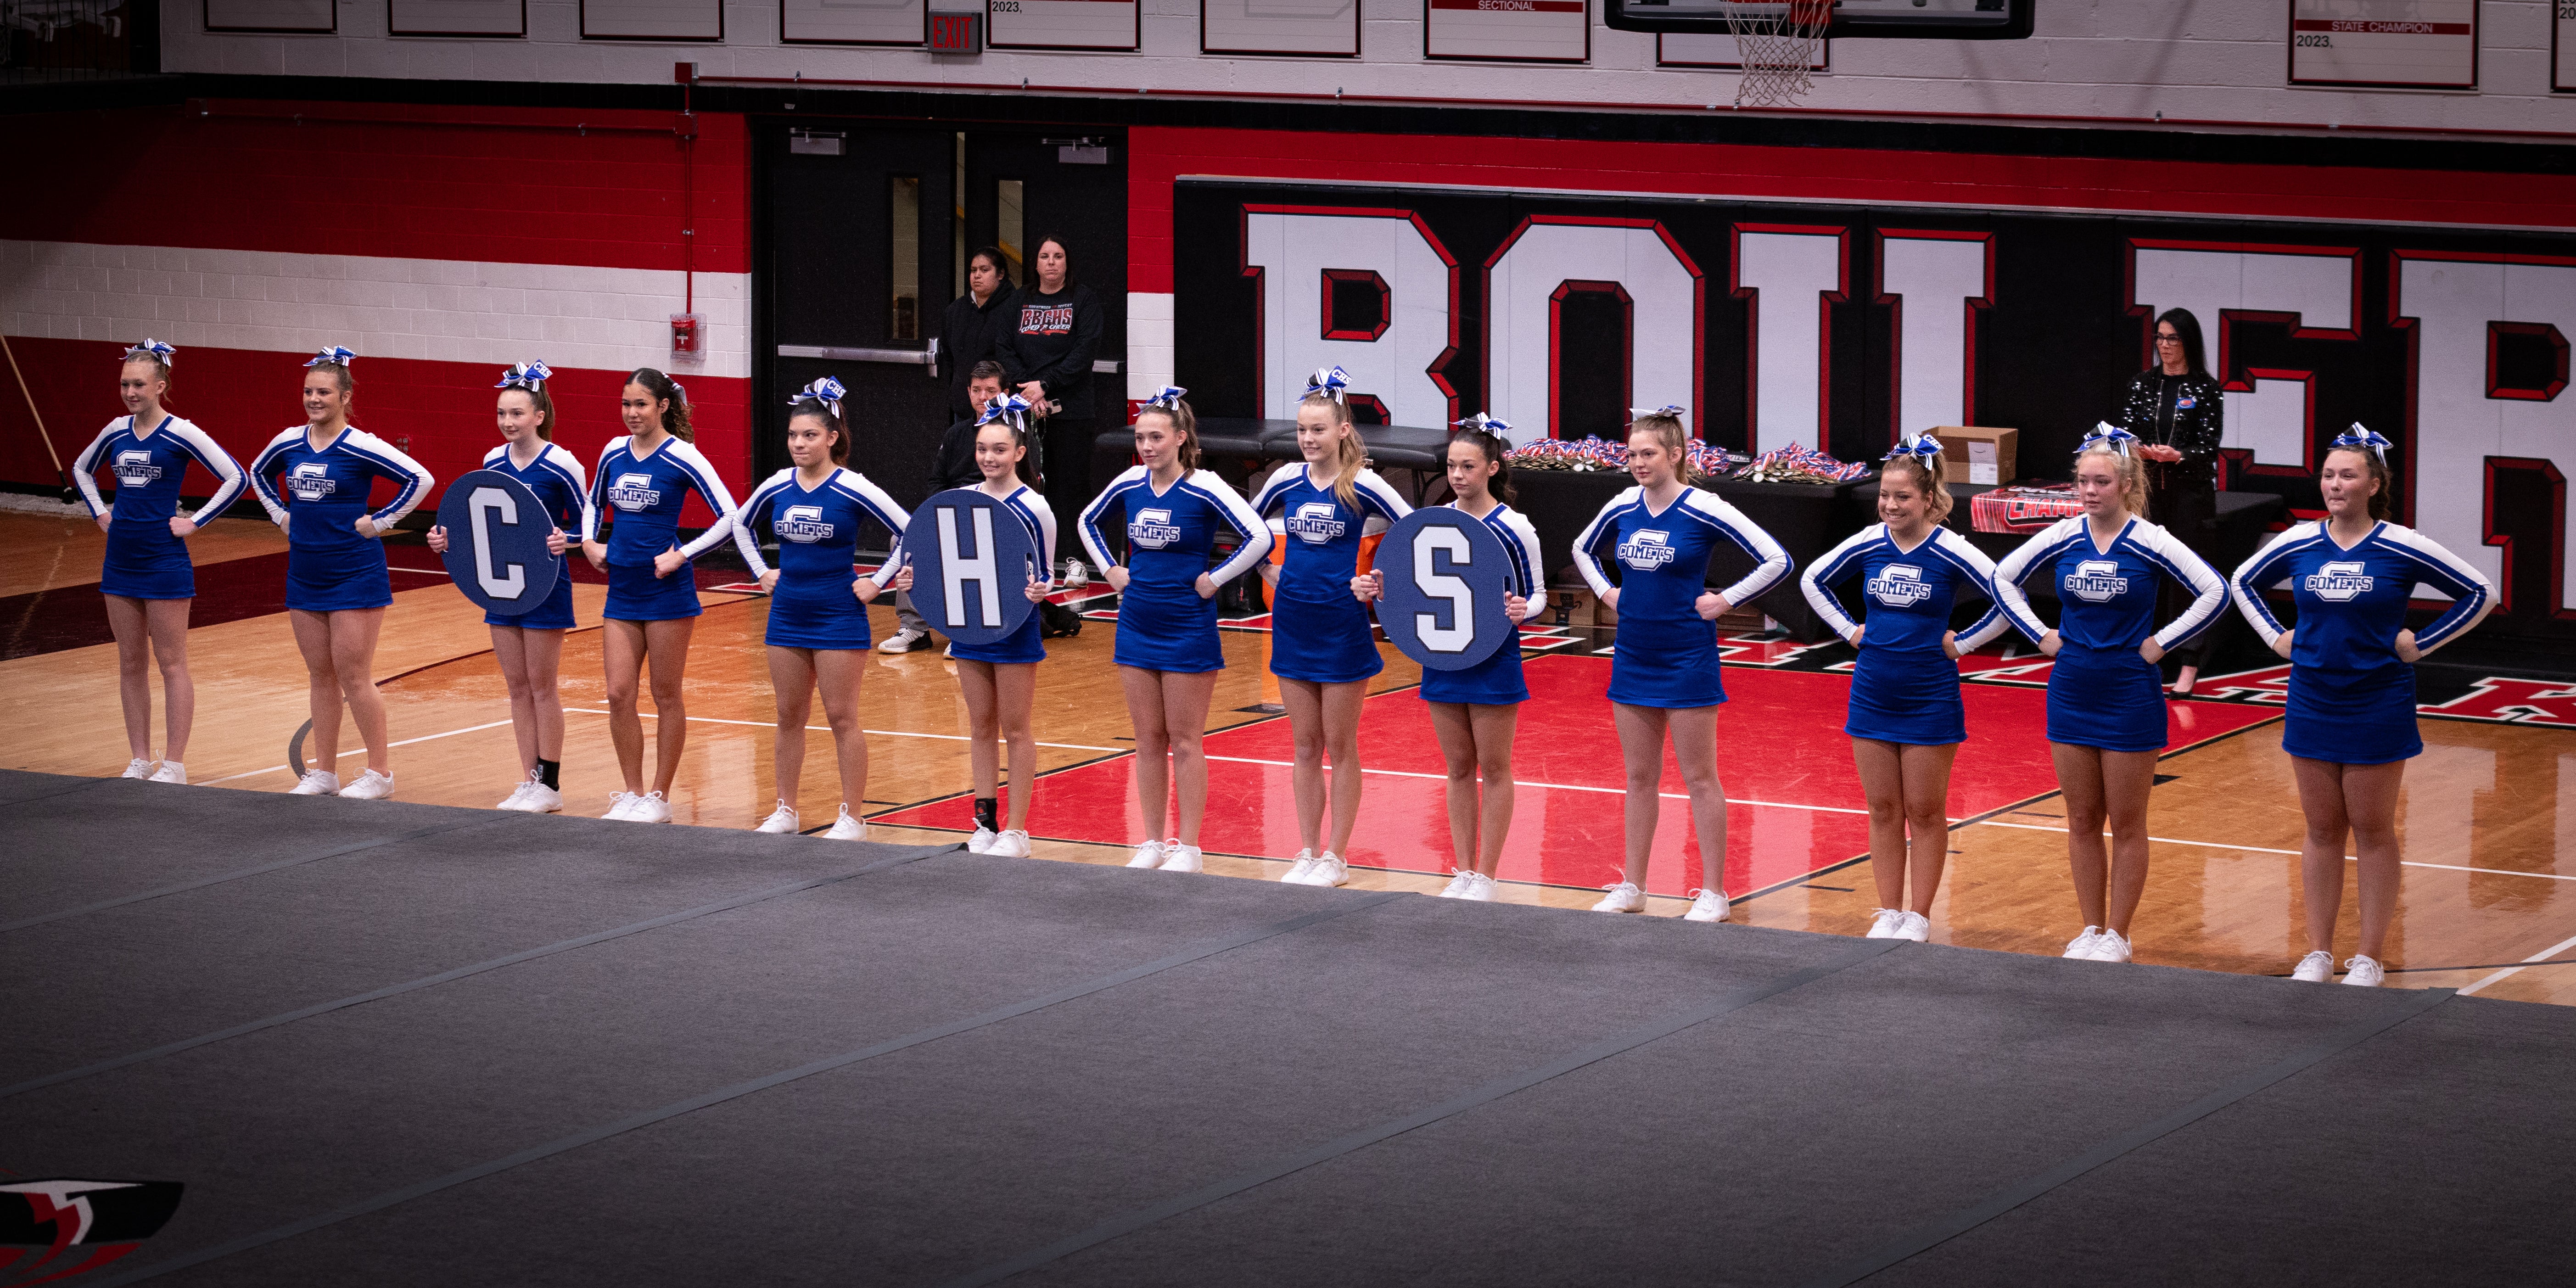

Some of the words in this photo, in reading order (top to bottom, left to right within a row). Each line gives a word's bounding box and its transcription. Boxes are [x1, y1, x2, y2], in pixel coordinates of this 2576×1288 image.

[992, 1, 1022, 13] 2023,
[1478, 0, 1535, 11] SECTIONAL
[934, 16, 972, 49] EXIT
[2331, 21, 2365, 32] STATE
[2368, 22, 2433, 34] CHAMPION
[2296, 35, 2333, 49] 2023,
[1019, 308, 1073, 330] BBCHS
[533, 361, 553, 378] CHS
[1331, 369, 1353, 385] CHS
[827, 380, 847, 398] CHS
[1923, 434, 1943, 449] CHS
[111, 465, 162, 479] COMETS
[286, 476, 336, 493] COMETS
[608, 487, 660, 505] COMETS
[774, 521, 834, 538] COMETS
[1128, 523, 1181, 542] COMETS
[1287, 517, 1345, 537] COMETS
[467, 485, 526, 600] C
[1617, 543, 1675, 563] COMETS
[935, 506, 1003, 628] H
[1411, 524, 1476, 655] S
[1867, 578, 1932, 600] COMETS
[2064, 574, 2127, 594] COMETS
[2305, 575, 2374, 592] COMETS
